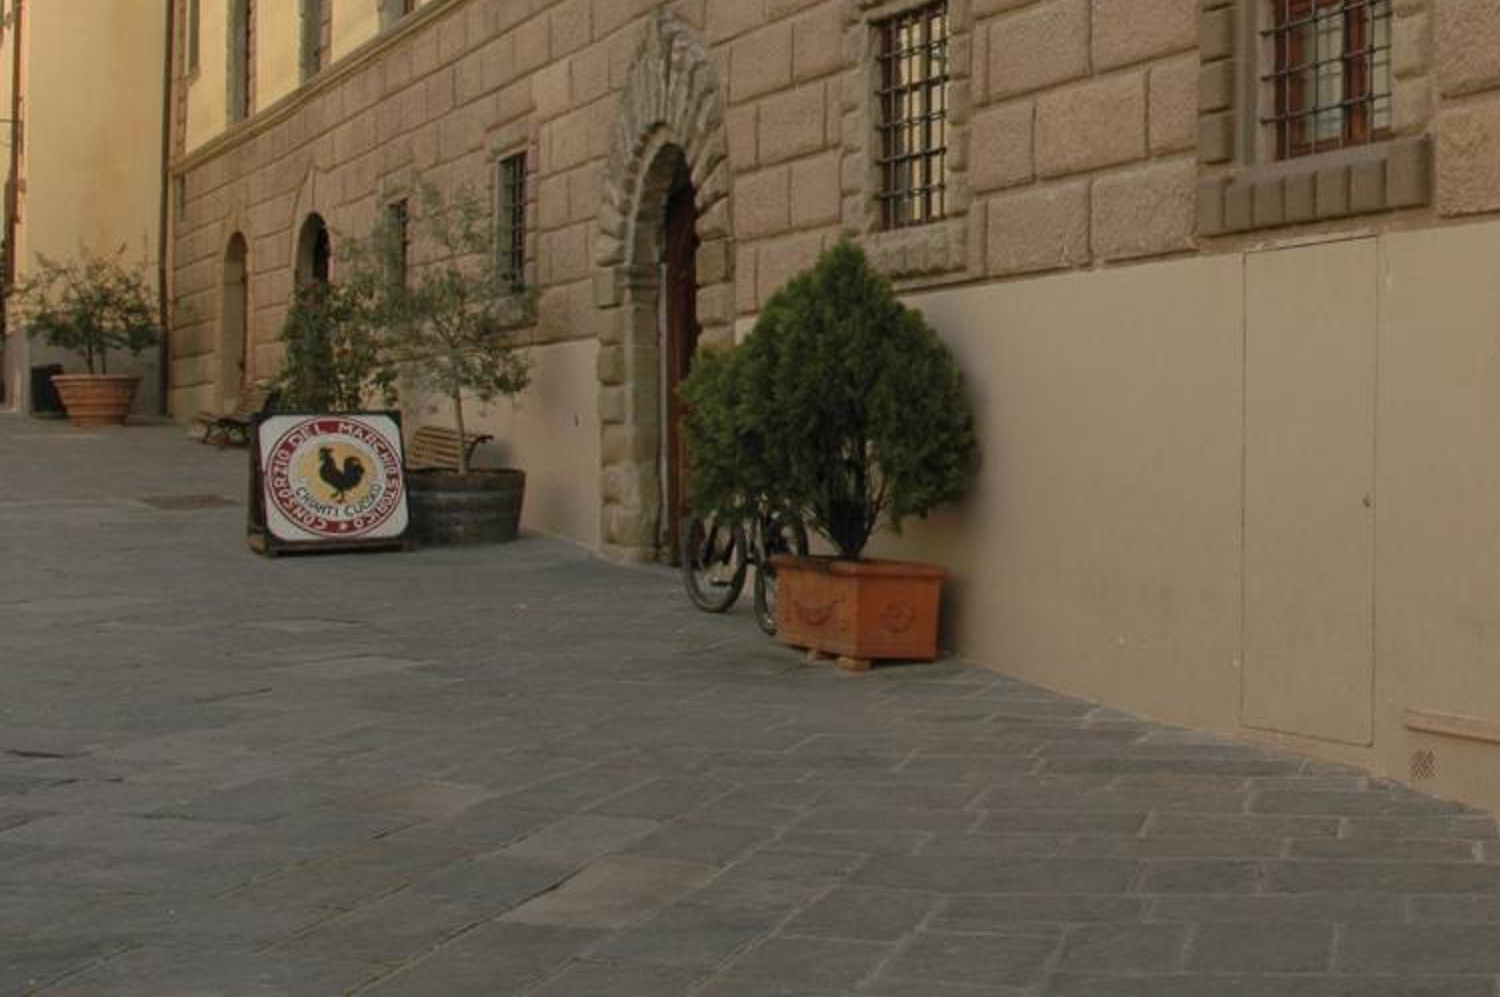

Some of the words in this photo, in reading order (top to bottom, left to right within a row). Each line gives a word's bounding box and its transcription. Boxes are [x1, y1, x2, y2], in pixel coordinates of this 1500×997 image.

[288, 423, 320, 446] DEL
[338, 422, 398, 473] MARCHIO
[272, 451, 328, 530] CONSORZIO
[296, 486, 339, 516] CHIANTI
[353, 477, 399, 528] STORICO
